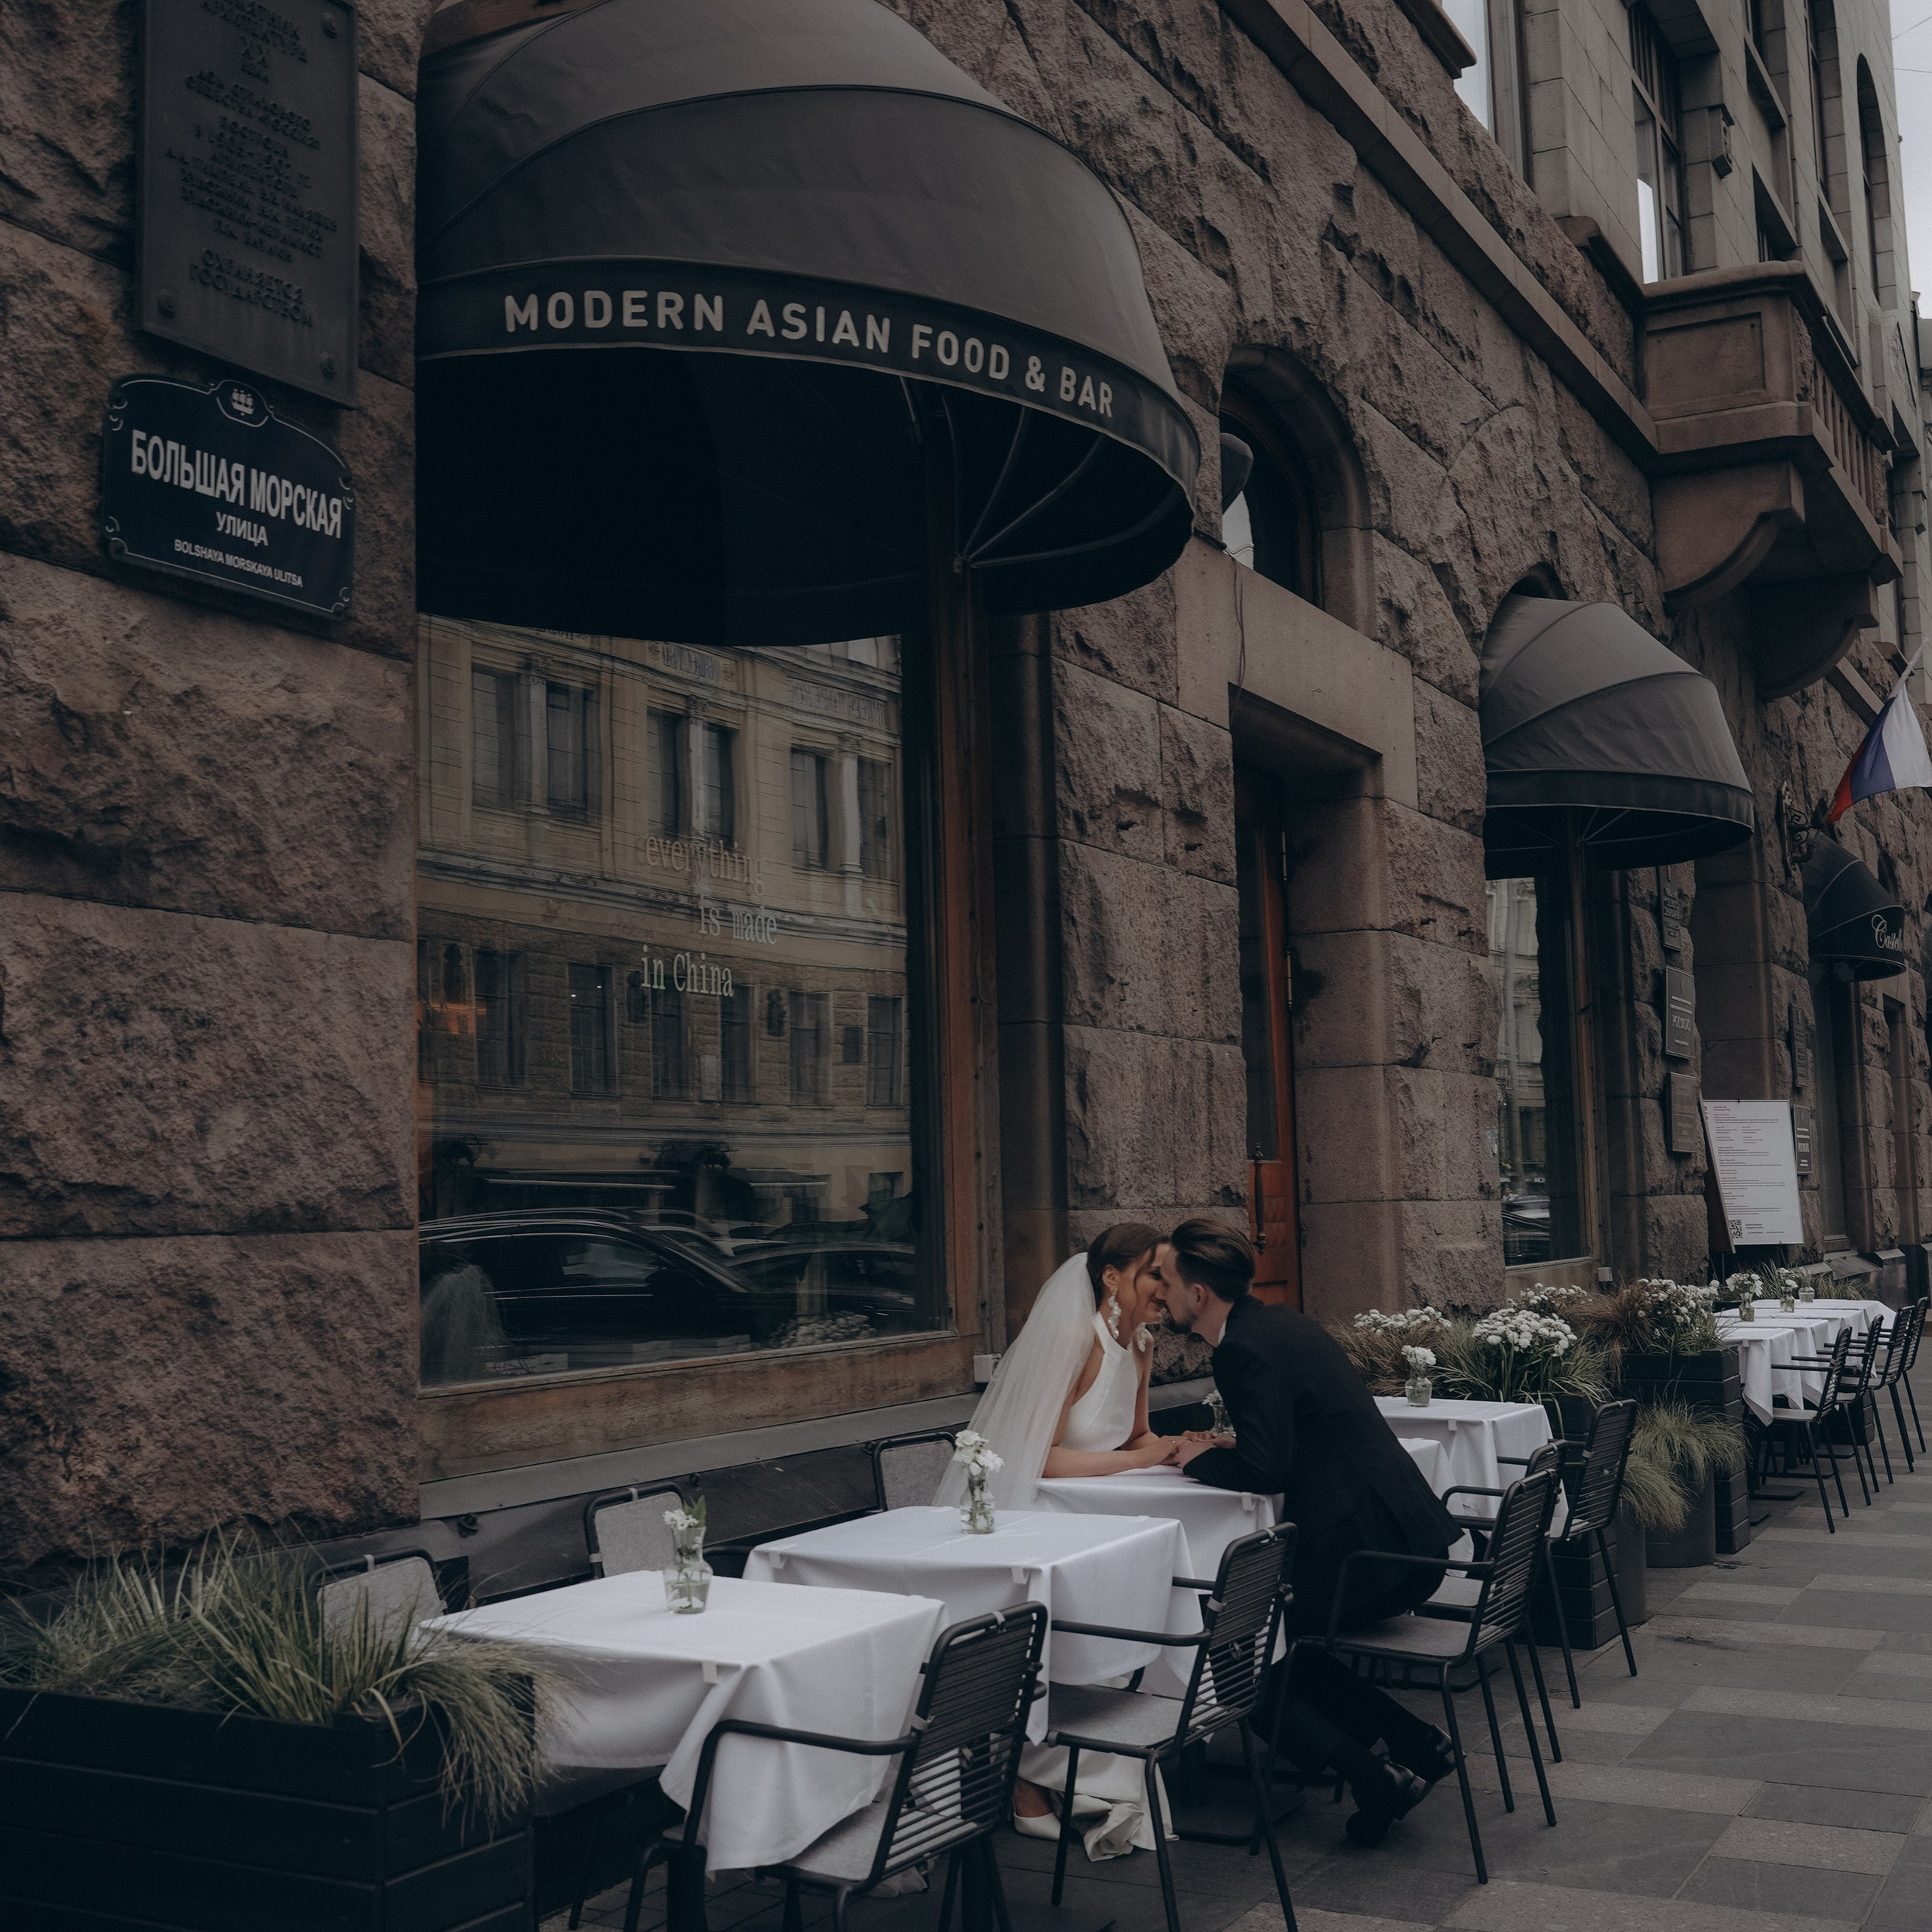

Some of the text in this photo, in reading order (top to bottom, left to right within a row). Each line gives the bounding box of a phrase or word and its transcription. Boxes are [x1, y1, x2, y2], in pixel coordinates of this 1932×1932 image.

[505, 290, 1114, 417] MODERN ASIAN FOOD & BAR
[131, 429, 342, 538] БОЛЬШАЯ МОРСКАЯ
[216, 512, 269, 546] УЛИЦА
[174, 539, 303, 588] BOLSHAYA MORSKAYA ULITSA
[645, 835, 764, 896] everything
[731, 906, 778, 945] made
[640, 944, 734, 998] in China
